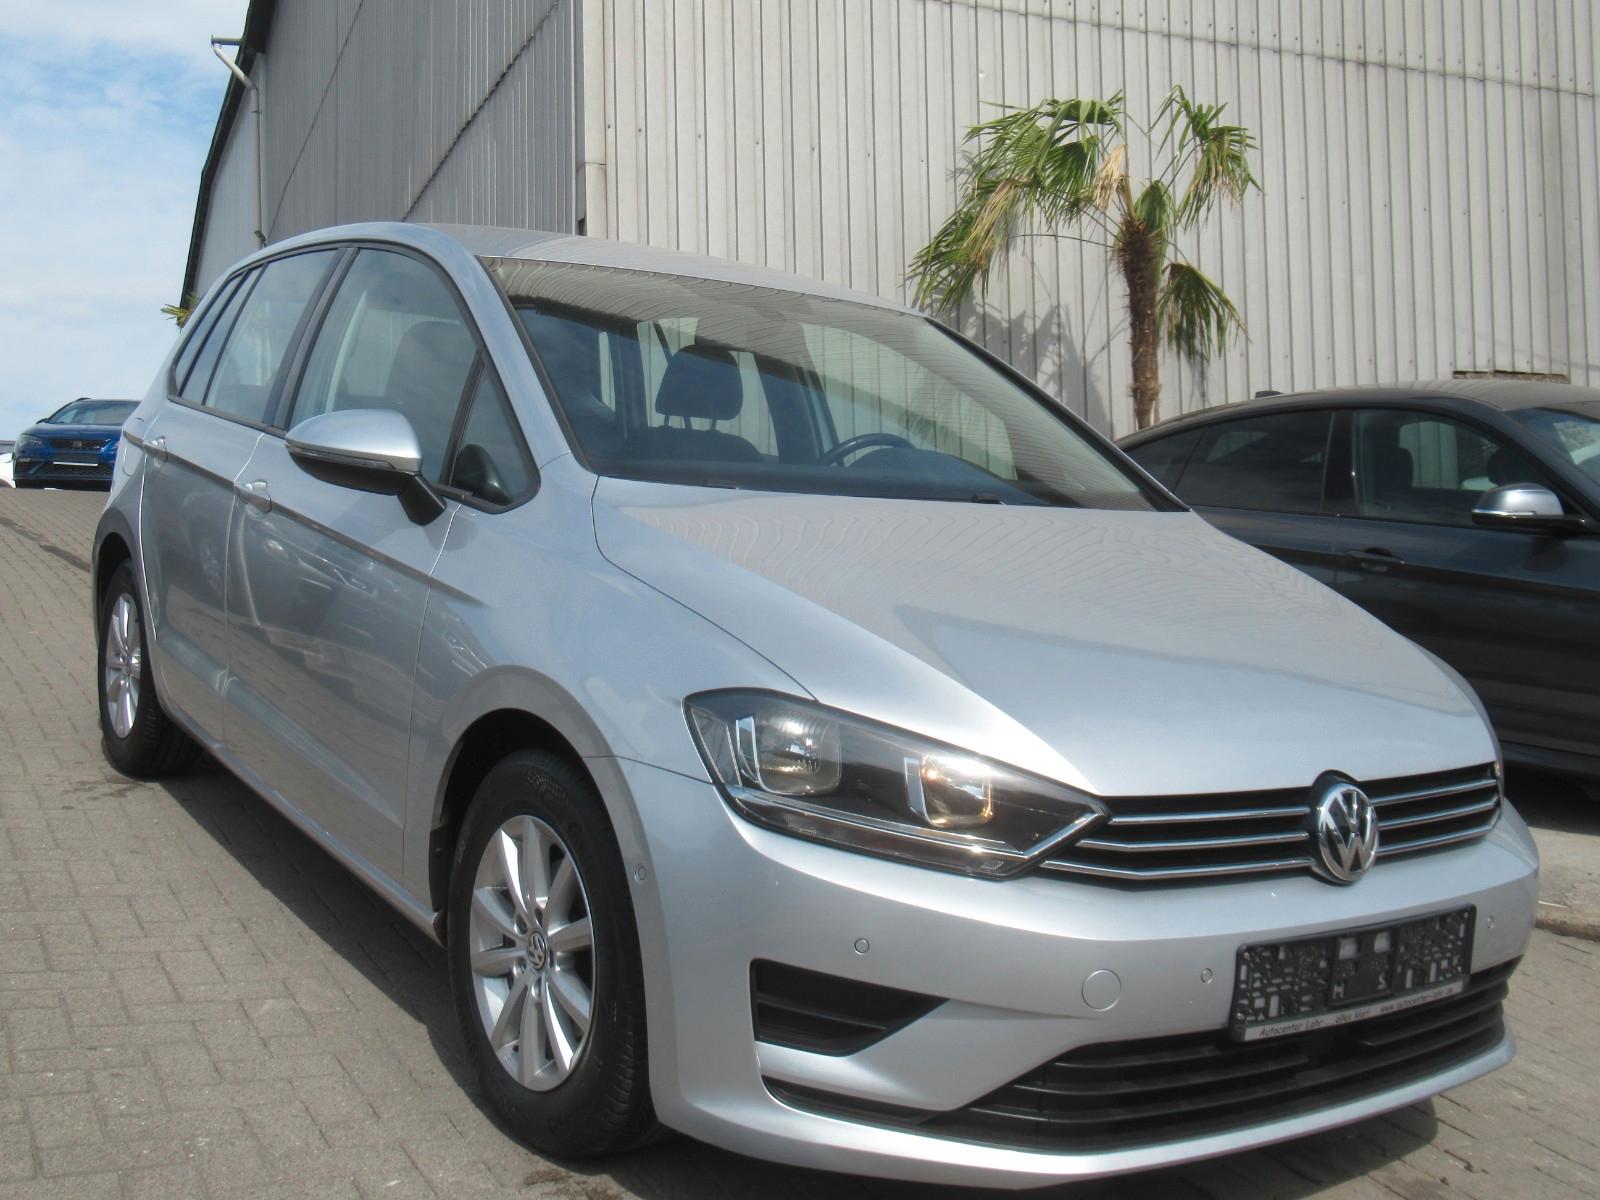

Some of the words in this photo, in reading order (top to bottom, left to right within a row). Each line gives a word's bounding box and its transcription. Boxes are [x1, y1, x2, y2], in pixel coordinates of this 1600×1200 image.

[1318, 783, 1378, 881] VW
[528, 931, 546, 971] VW
[1259, 1022, 1303, 1037] Autocenter
